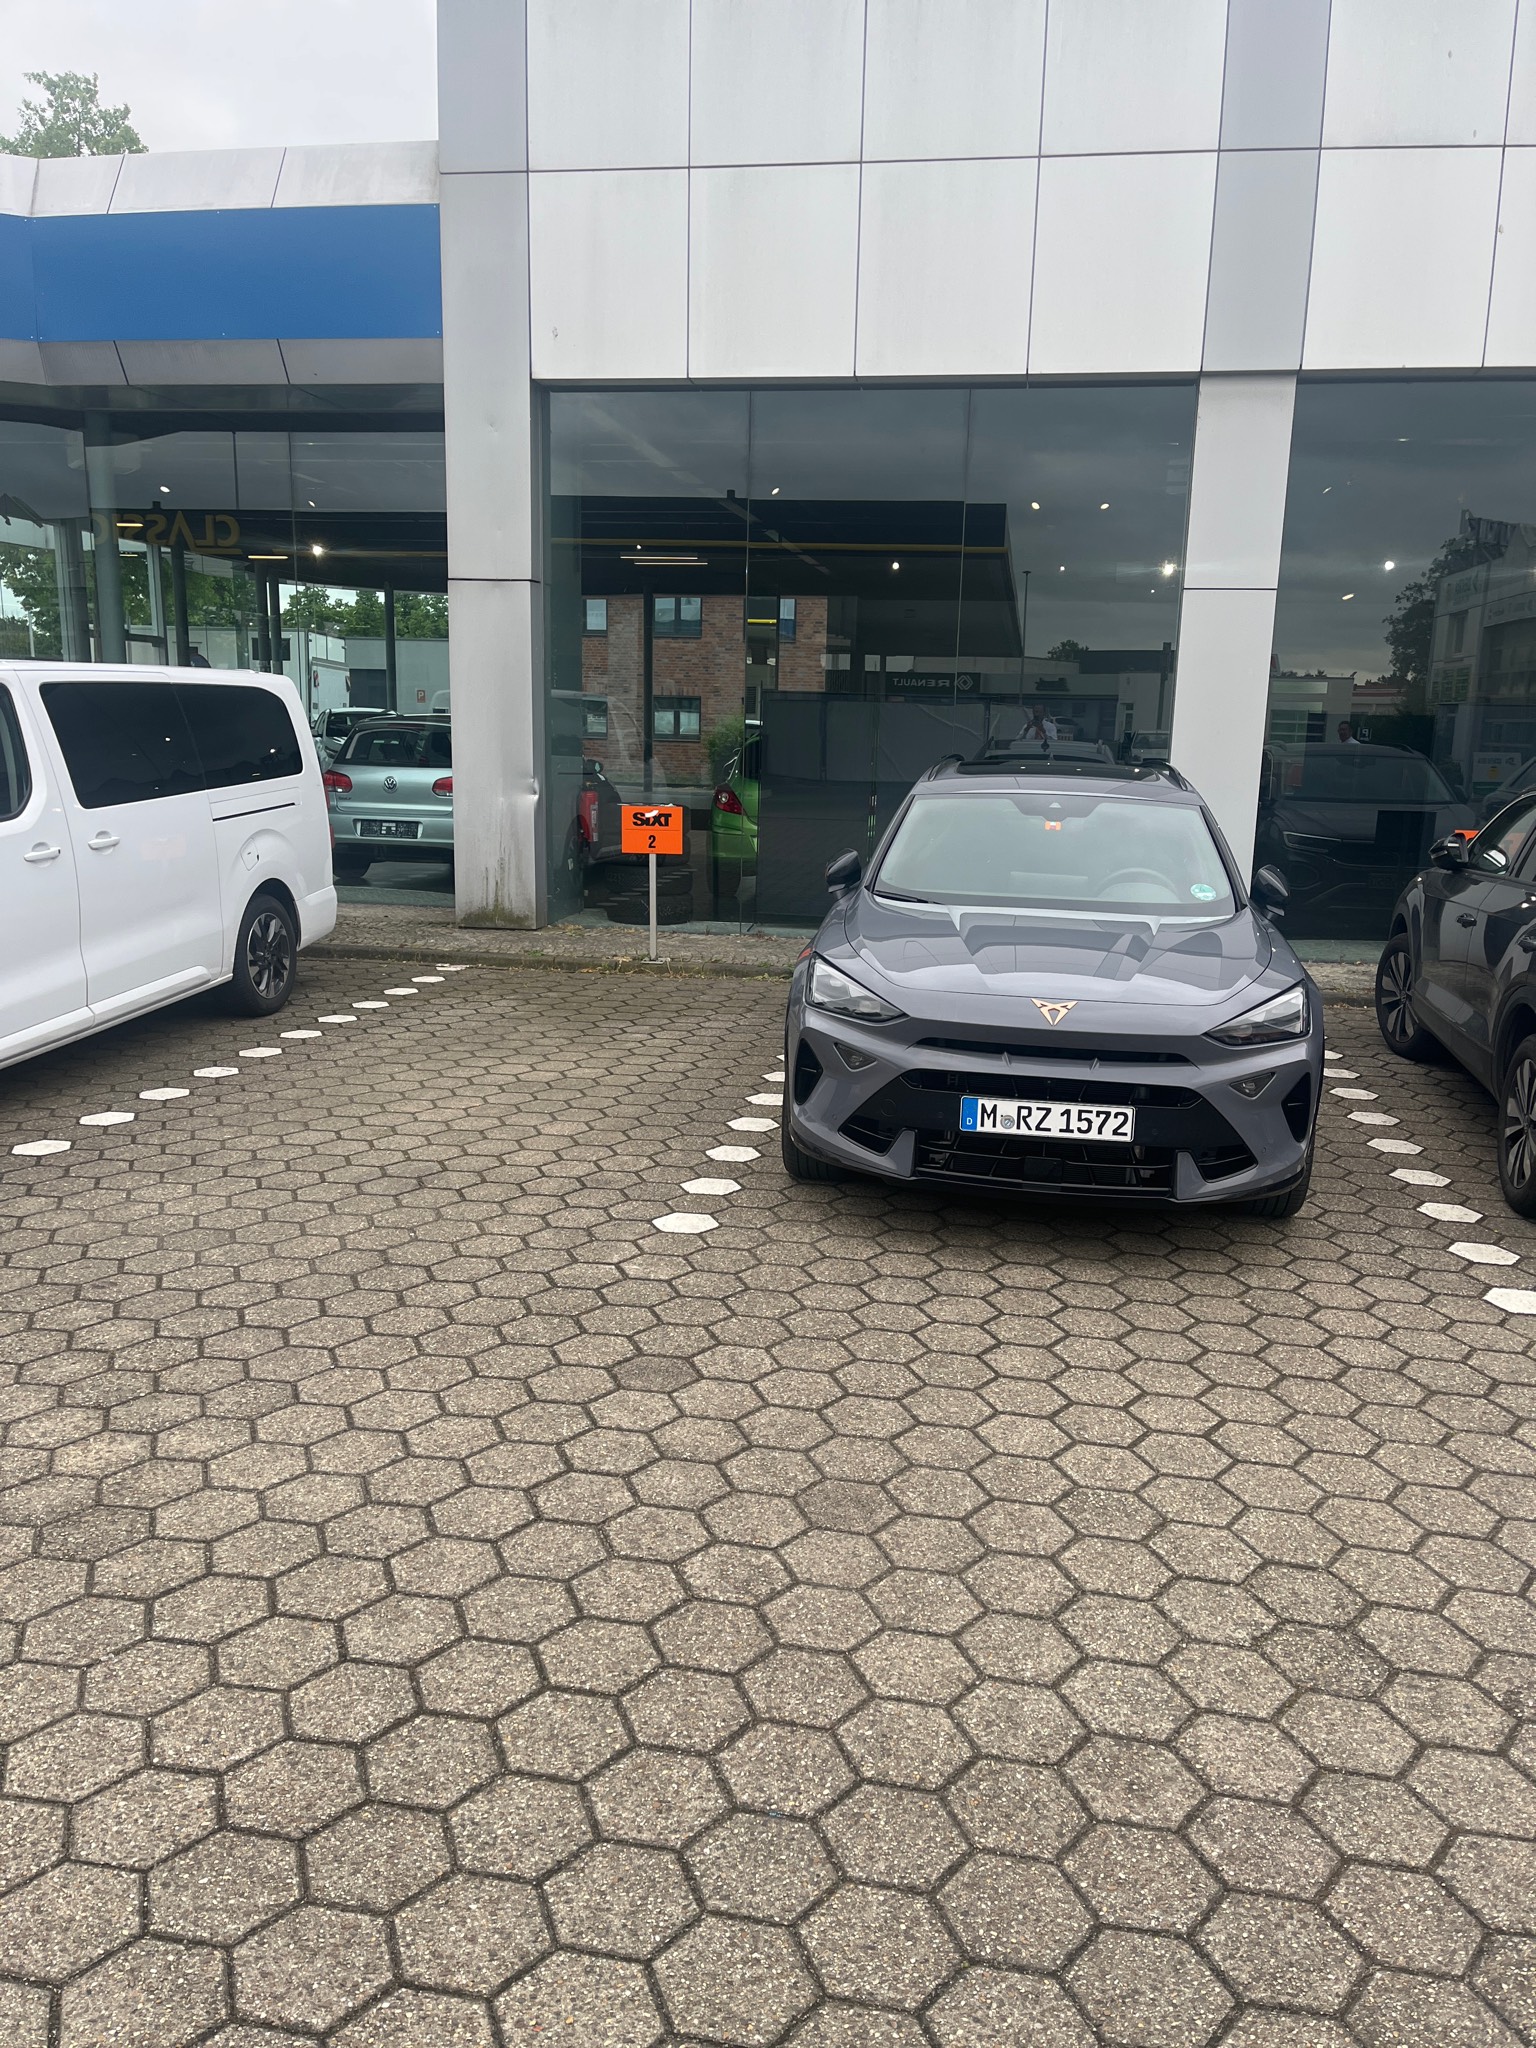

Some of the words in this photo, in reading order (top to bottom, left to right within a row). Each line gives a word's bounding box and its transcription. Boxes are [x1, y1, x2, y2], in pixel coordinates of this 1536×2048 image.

[632, 810, 672, 827] SIXT
[648, 835, 656, 849] 2
[966, 1117, 973, 1125] D
[980, 1103, 998, 1128] M
[1016, 1105, 1053, 1132] RZ
[1059, 1108, 1129, 1137] 1572
